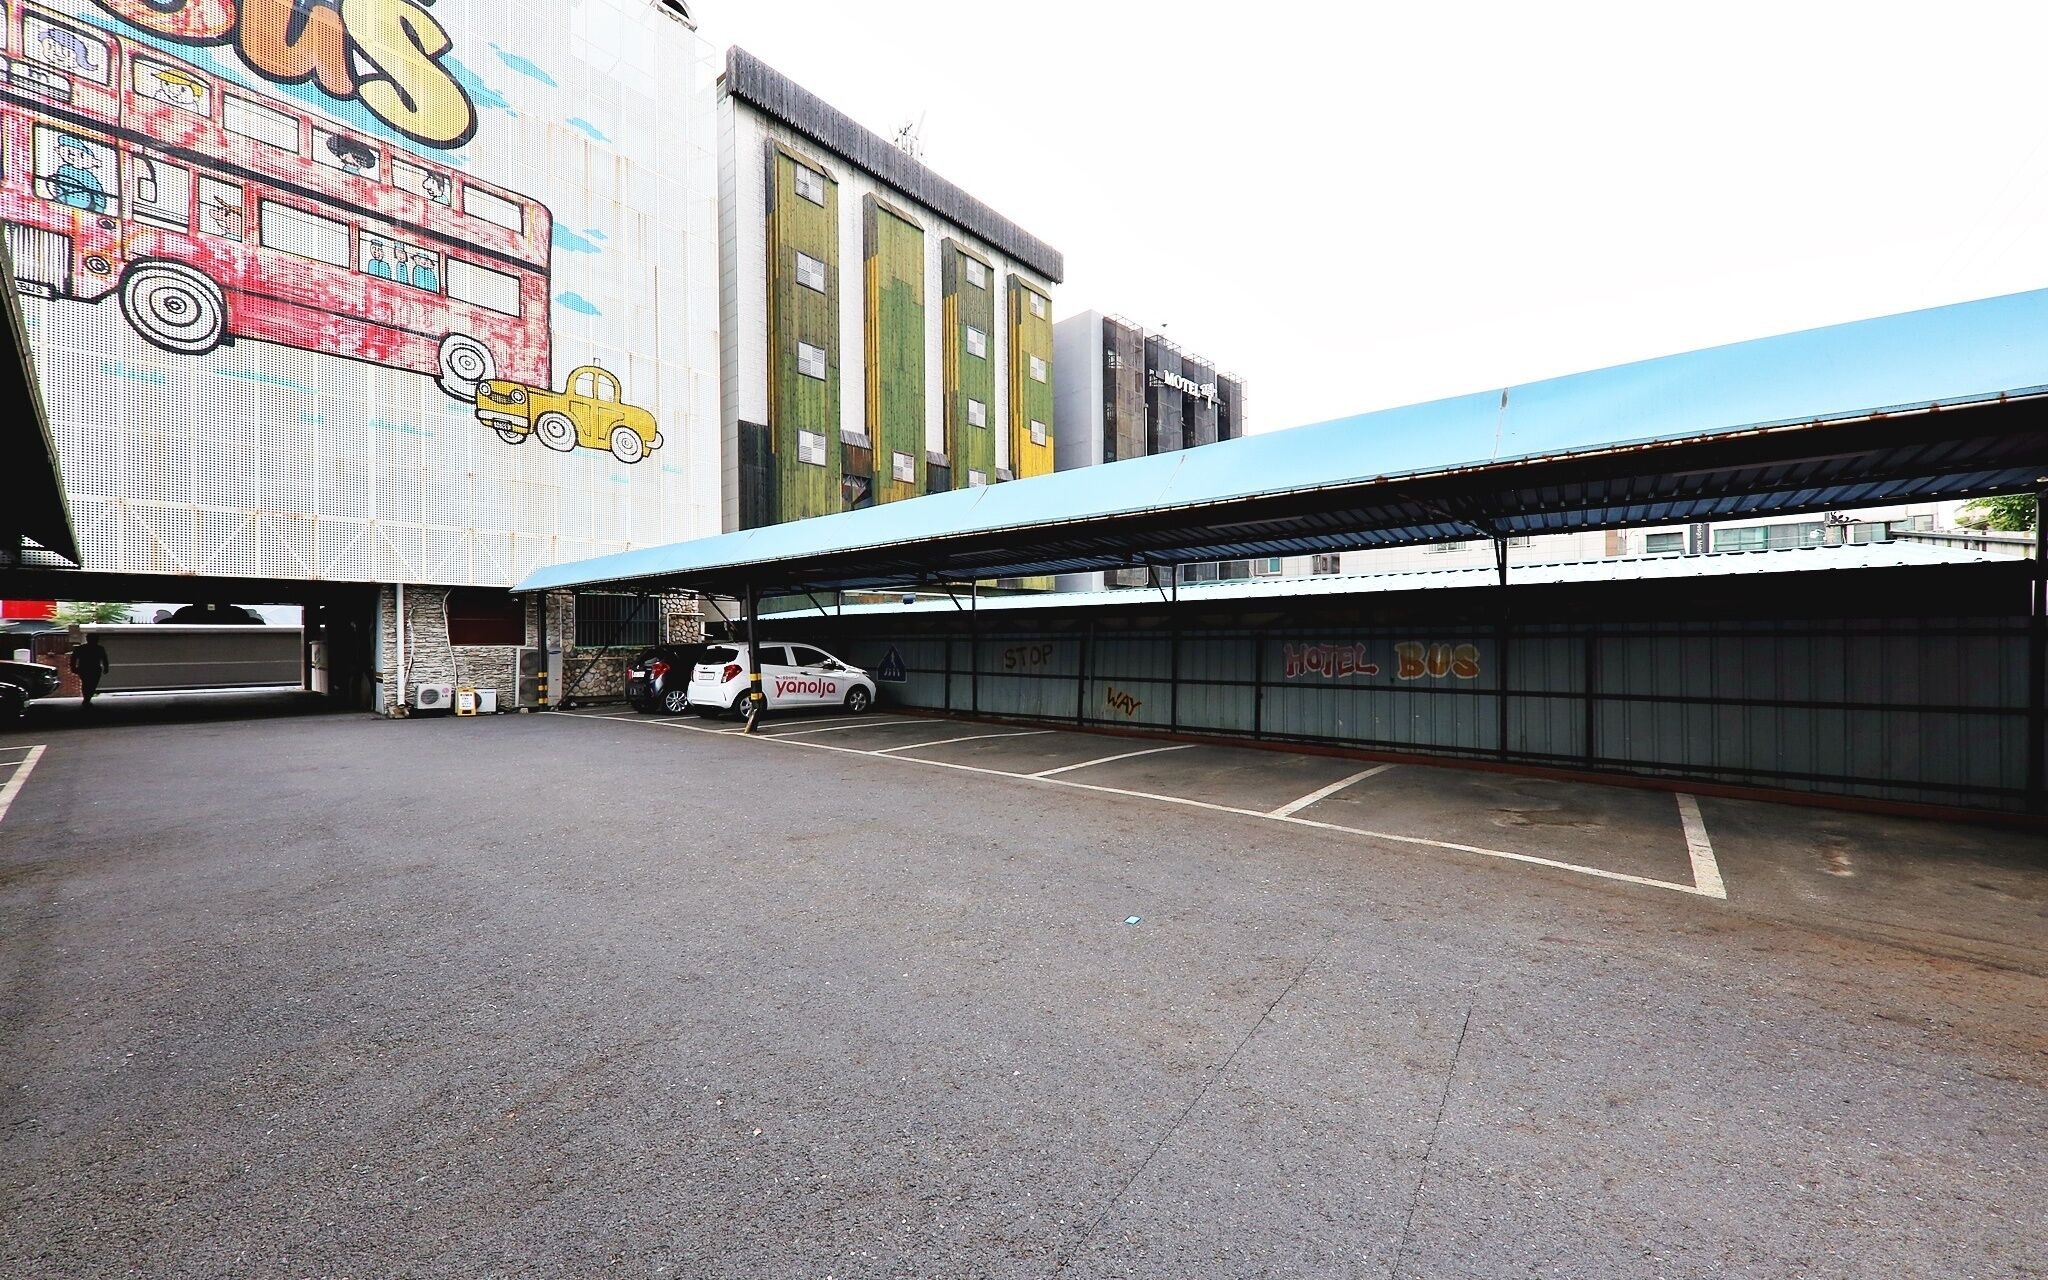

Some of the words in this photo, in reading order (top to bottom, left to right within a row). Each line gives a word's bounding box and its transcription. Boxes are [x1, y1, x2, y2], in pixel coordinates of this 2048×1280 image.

[1163, 369, 1201, 398] MOTEL
[1004, 644, 1053, 669] STOP
[1285, 642, 1379, 678] HOTEL
[1395, 641, 1480, 680] BUS
[775, 678, 836, 698] yanolja
[1107, 686, 1142, 716] WAY
